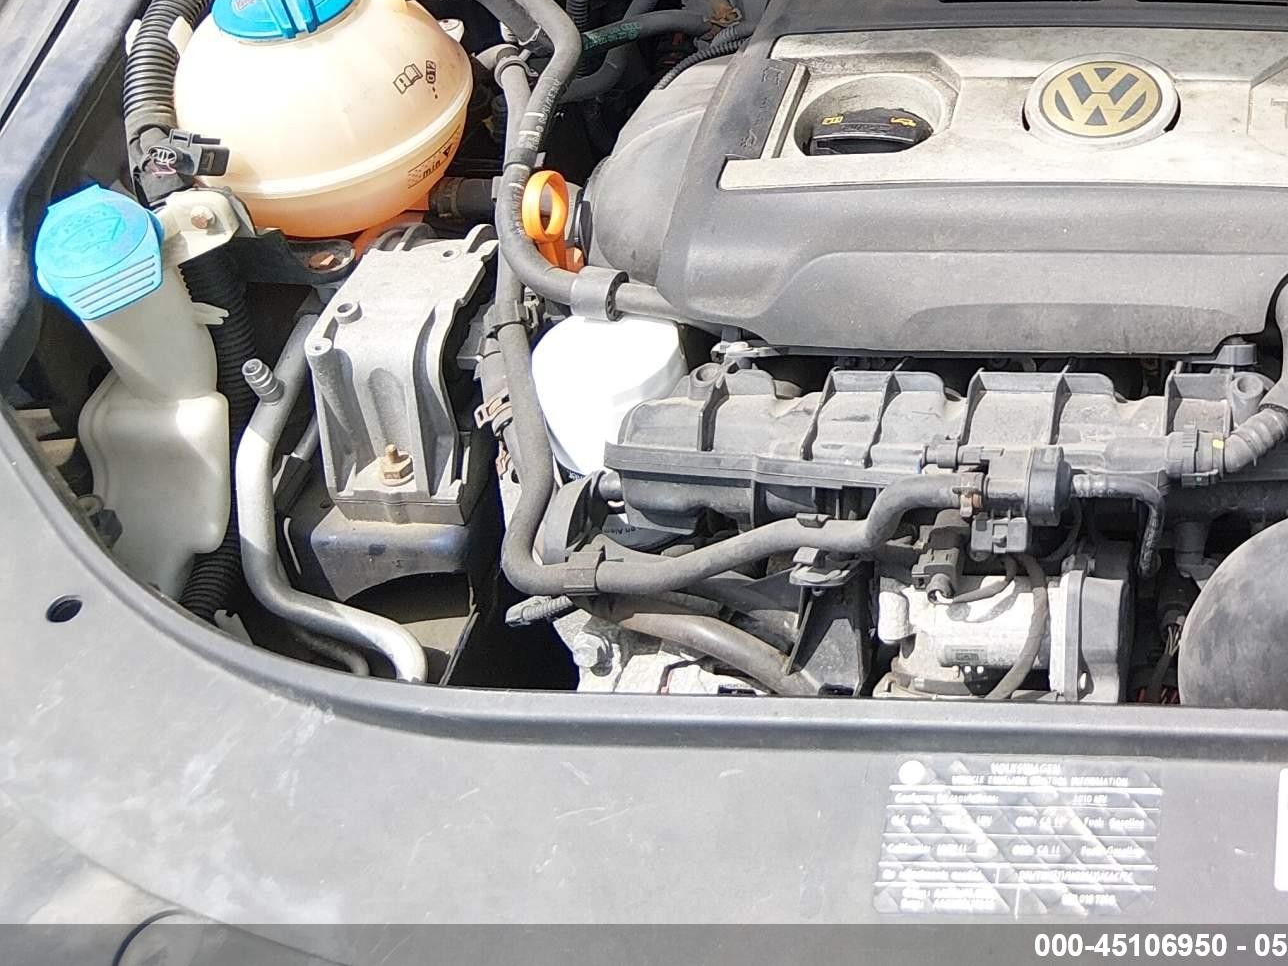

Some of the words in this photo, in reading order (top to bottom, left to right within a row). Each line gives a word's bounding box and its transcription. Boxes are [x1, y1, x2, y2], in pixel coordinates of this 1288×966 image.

[422, 159, 441, 180] min
[991, 763, 1061, 775] VOLKSWAGEN
[1071, 777, 1128, 787] INFORMATION
